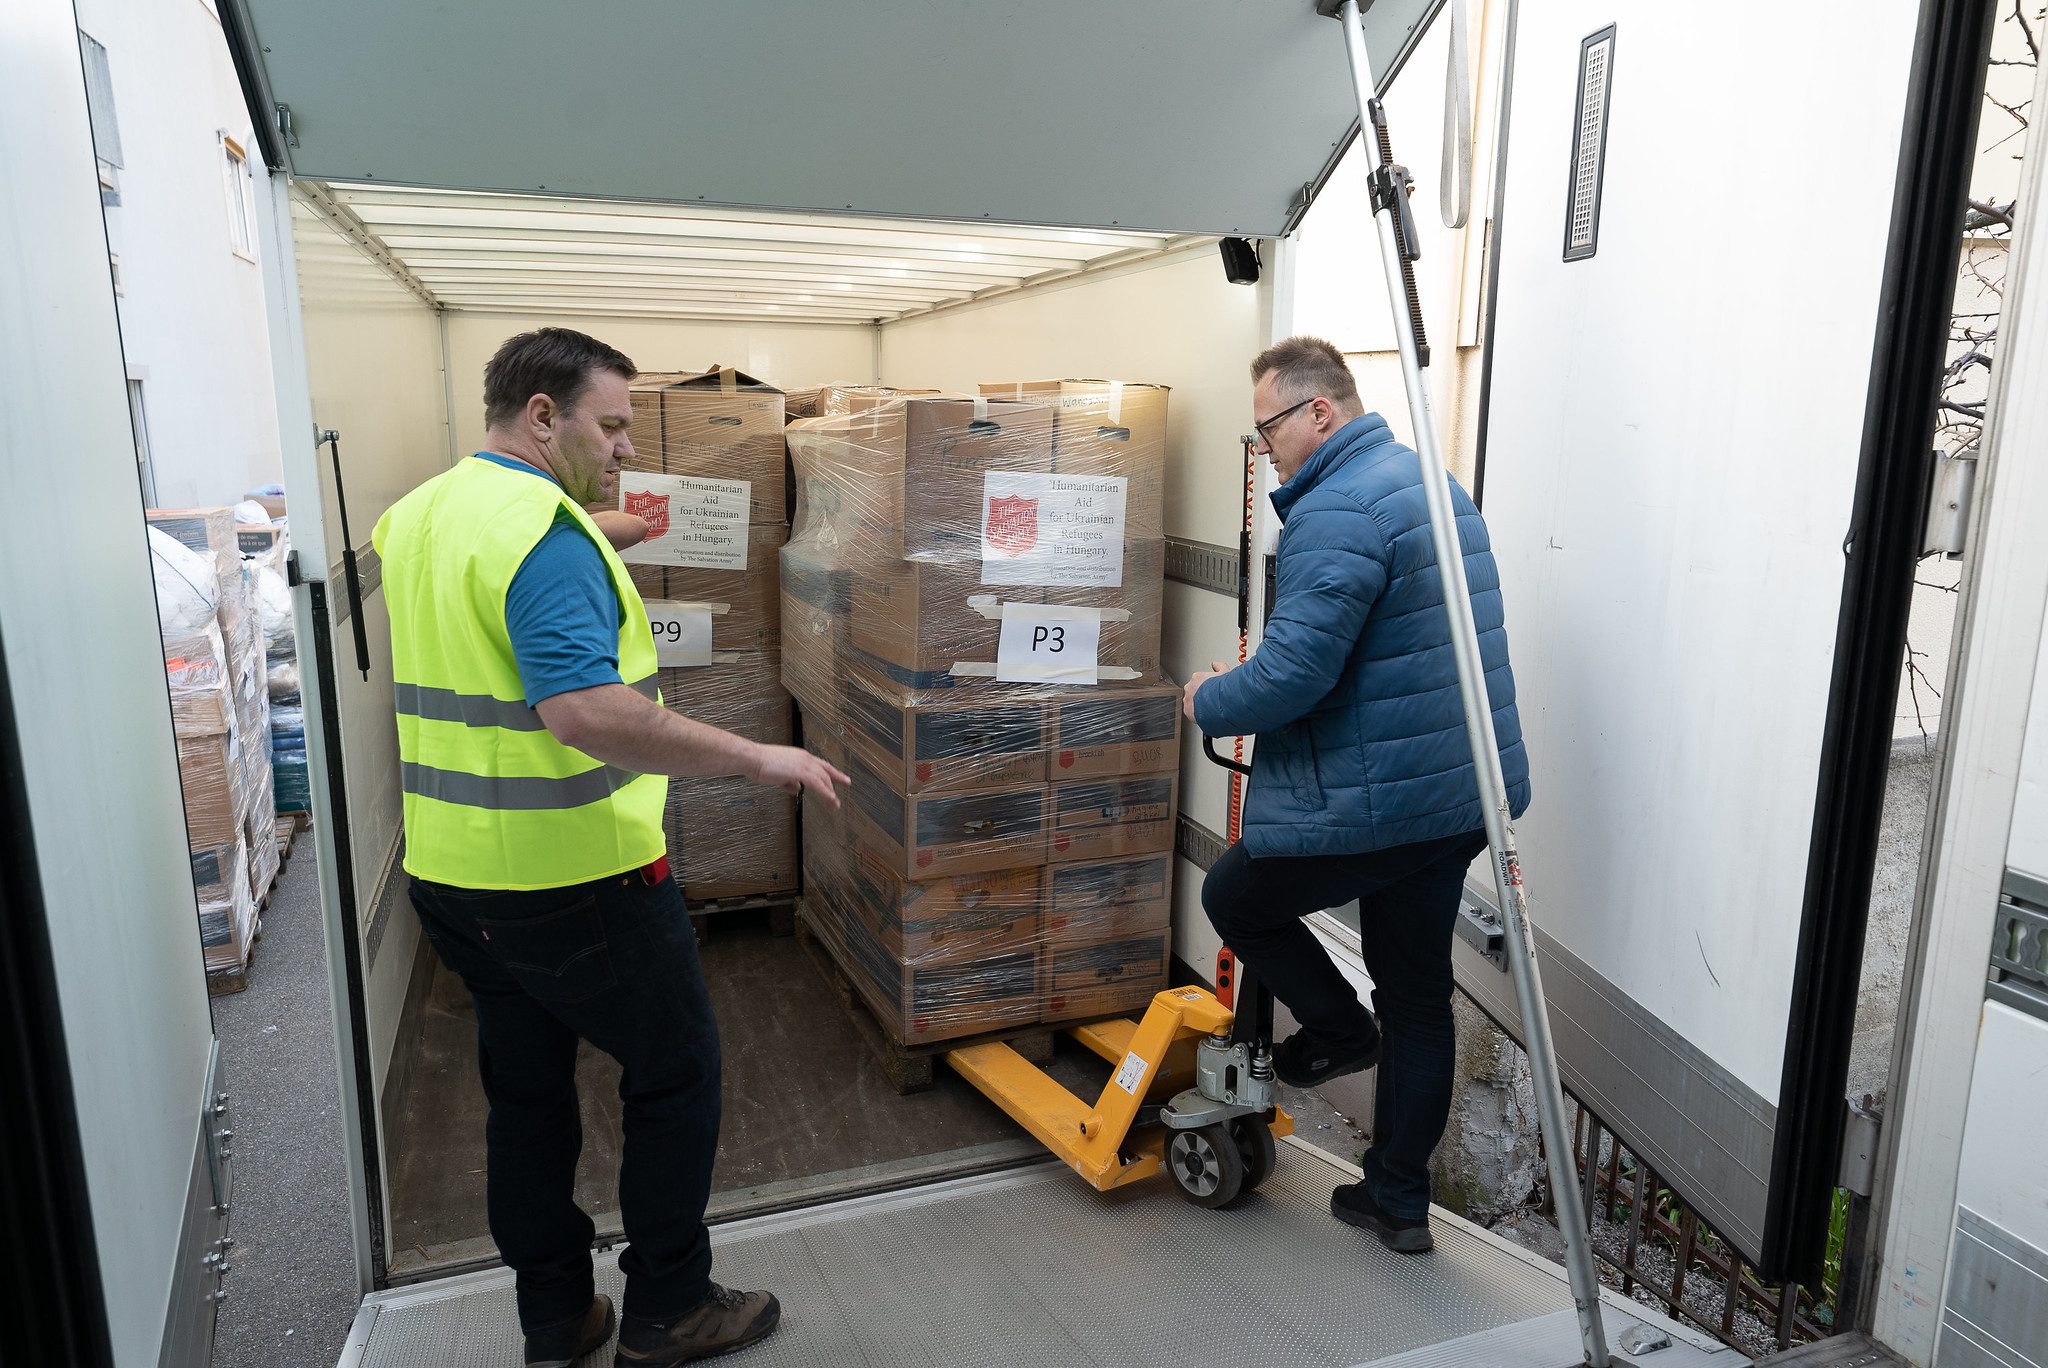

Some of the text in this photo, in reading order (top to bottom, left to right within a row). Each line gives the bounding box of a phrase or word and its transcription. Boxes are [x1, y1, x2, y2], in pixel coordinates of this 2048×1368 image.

[632, 497, 651, 511] THE
[702, 496, 719, 505] Aid
[1074, 497, 1092, 508] Aid
[680, 506, 739, 519] for Ukrainian
[1050, 511, 1115, 524] for Ukrainian
[690, 520, 729, 531] Refugees
[682, 533, 734, 546] in Hungary.
[1061, 529, 1104, 541] Refugees
[1054, 545, 1109, 559] in Hungary.
[651, 621, 682, 642] P9
[1032, 625, 1065, 653] P3
[1498, 851, 1510, 887] ROADWIN
